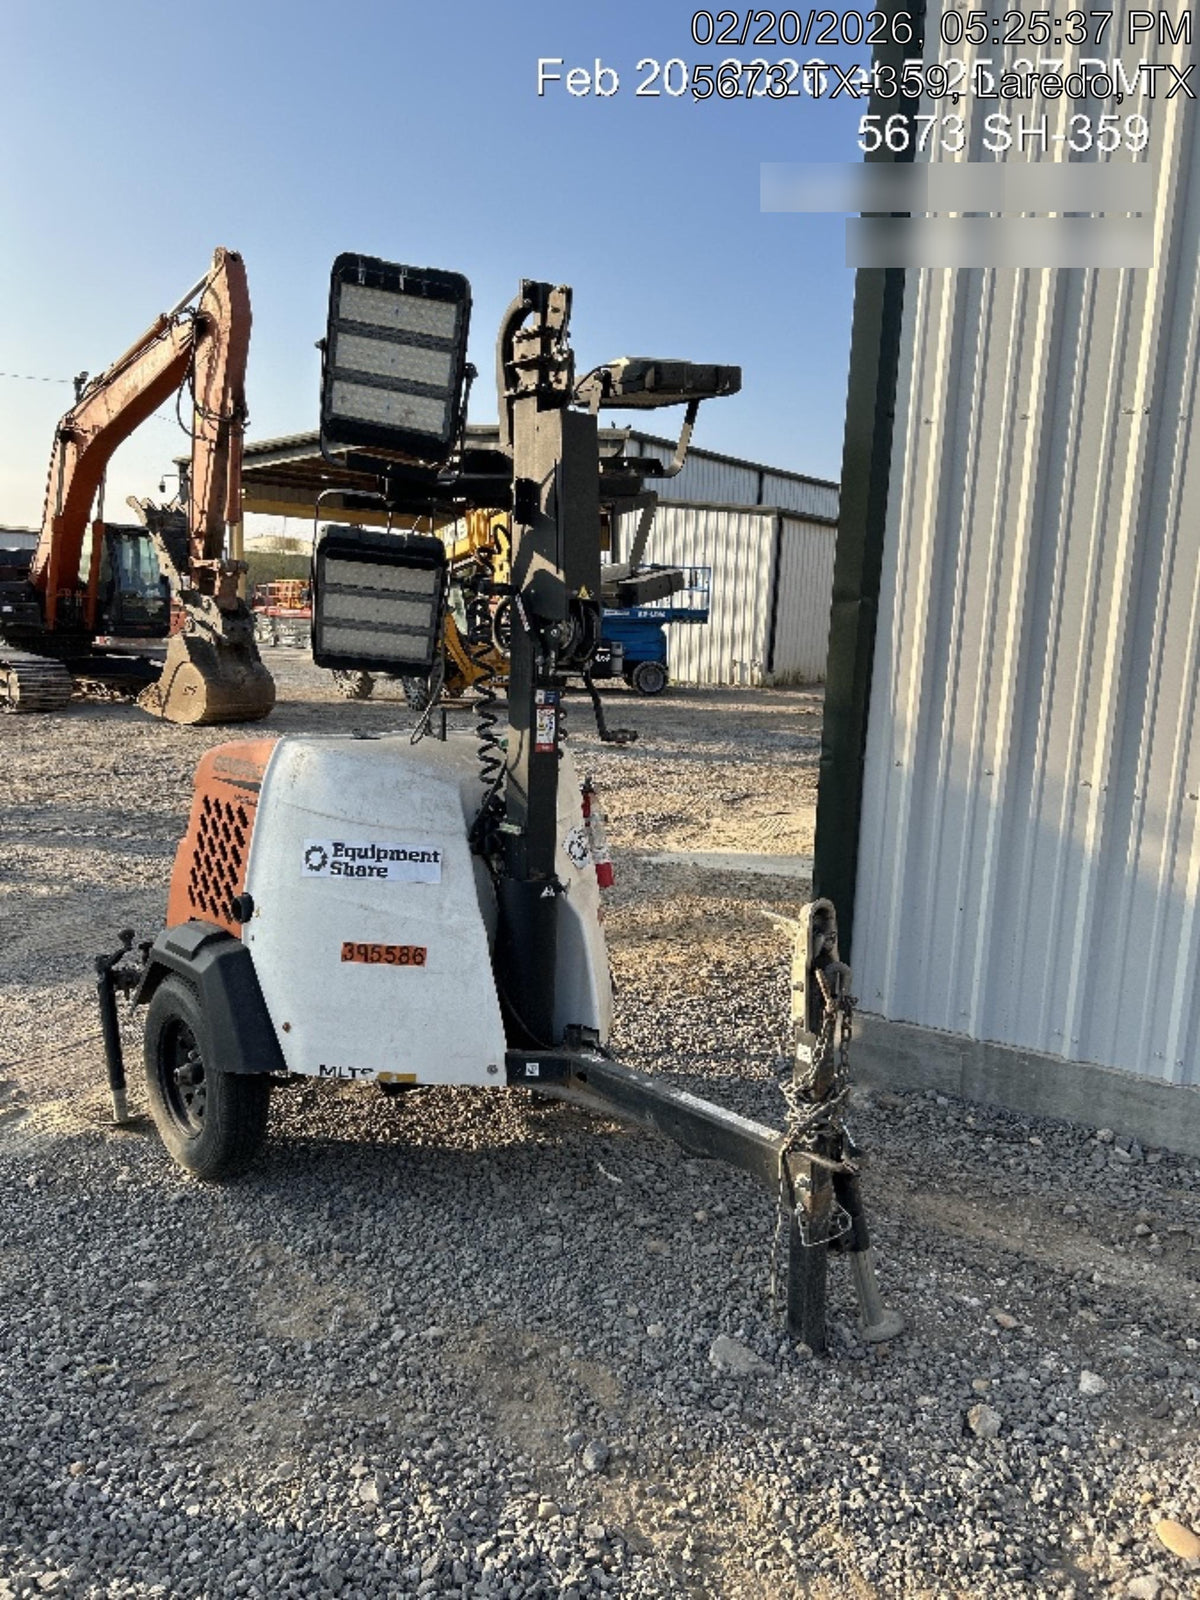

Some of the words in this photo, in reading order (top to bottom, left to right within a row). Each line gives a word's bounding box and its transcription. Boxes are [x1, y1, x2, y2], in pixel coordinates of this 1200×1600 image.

[332, 842, 441, 863] Equipment
[330, 861, 389, 879] Share
[342, 942, 426, 966] 395586
